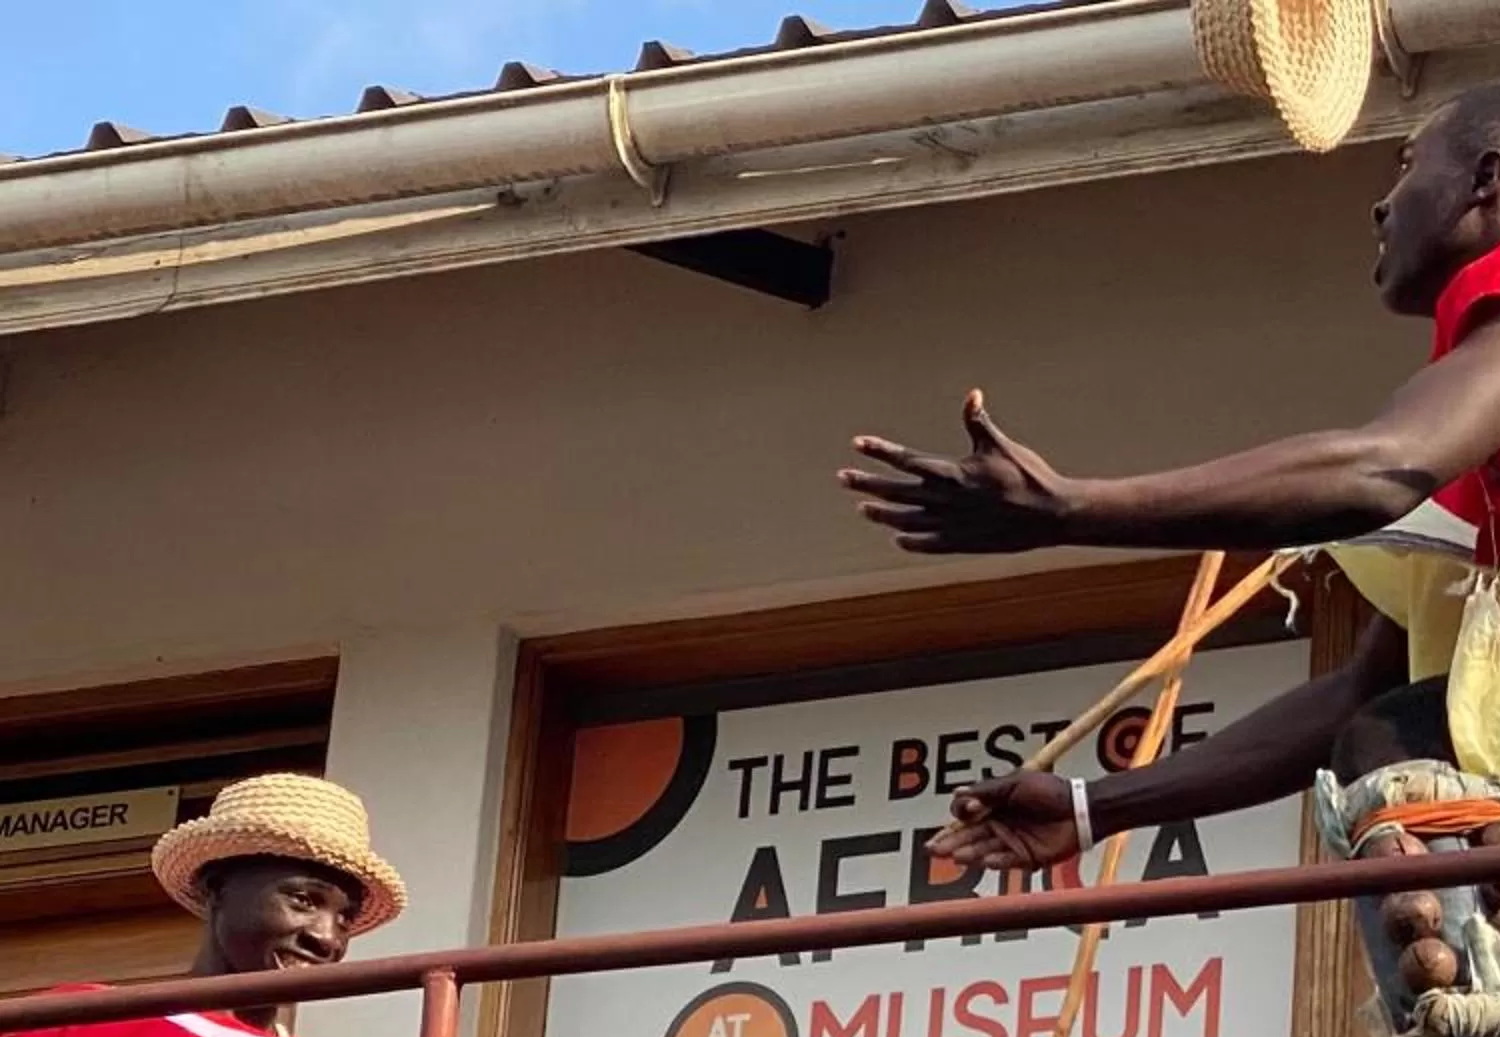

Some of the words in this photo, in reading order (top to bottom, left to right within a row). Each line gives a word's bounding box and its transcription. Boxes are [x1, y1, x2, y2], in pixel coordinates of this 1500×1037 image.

[729, 746, 860, 820] THE
[888, 719, 1074, 801] BEST
[1096, 702, 1215, 773] OF
[0, 803, 129, 837] MANAGER
